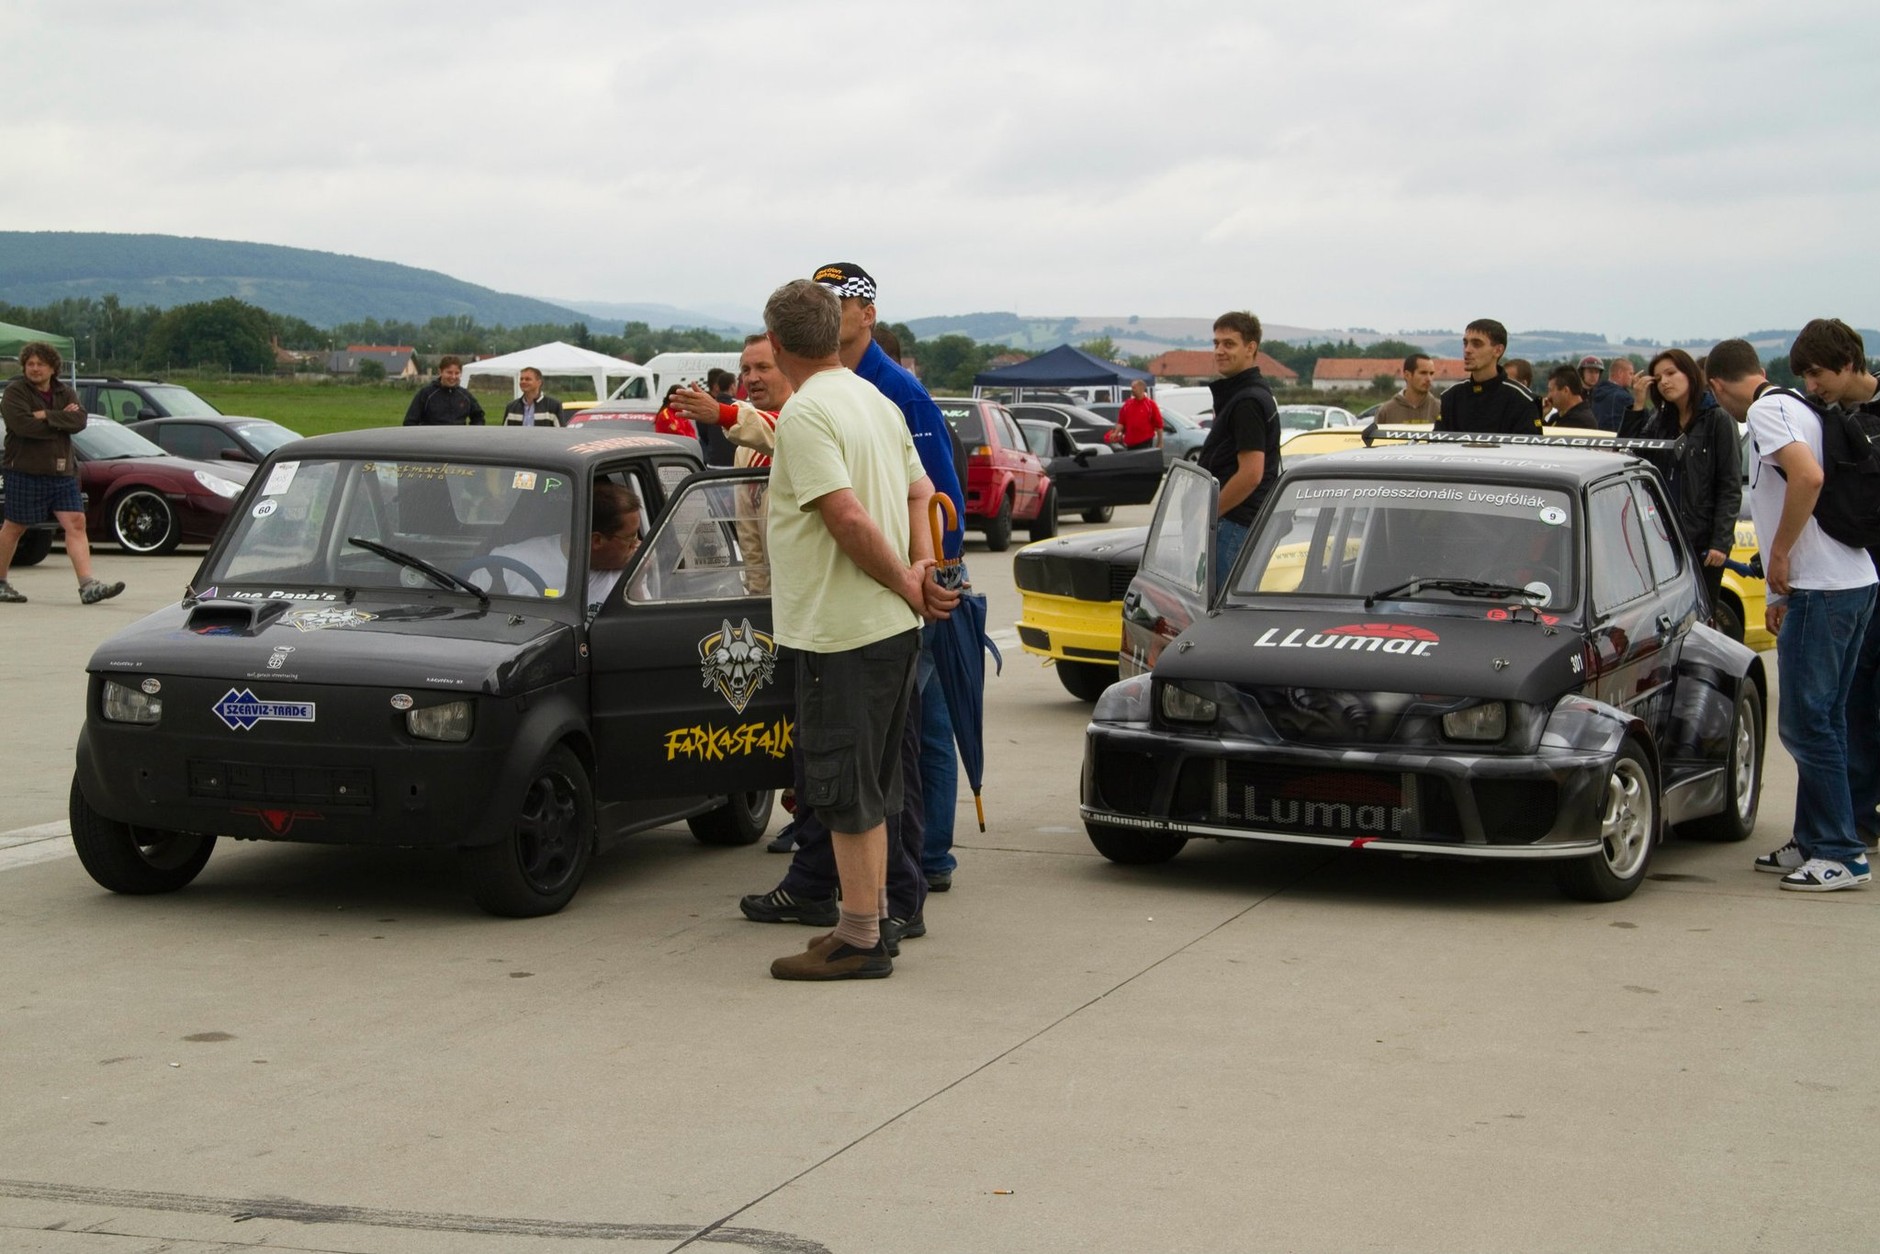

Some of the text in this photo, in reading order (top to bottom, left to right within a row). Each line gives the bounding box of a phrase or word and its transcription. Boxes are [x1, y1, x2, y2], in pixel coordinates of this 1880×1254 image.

[1386, 430, 1667, 449] WWW.AUTOMAGIC.HU
[1296, 486, 1546, 508] LLumar professzionális üvegfóliák
[257, 505, 271, 516] 60
[1549, 512, 1557, 521] 9
[1253, 626, 1440, 656] LLumar
[1570, 653, 1584, 674] 301
[226, 701, 308, 717] SZERVIZ-TRADE
[1217, 781, 1412, 831] LLumar
